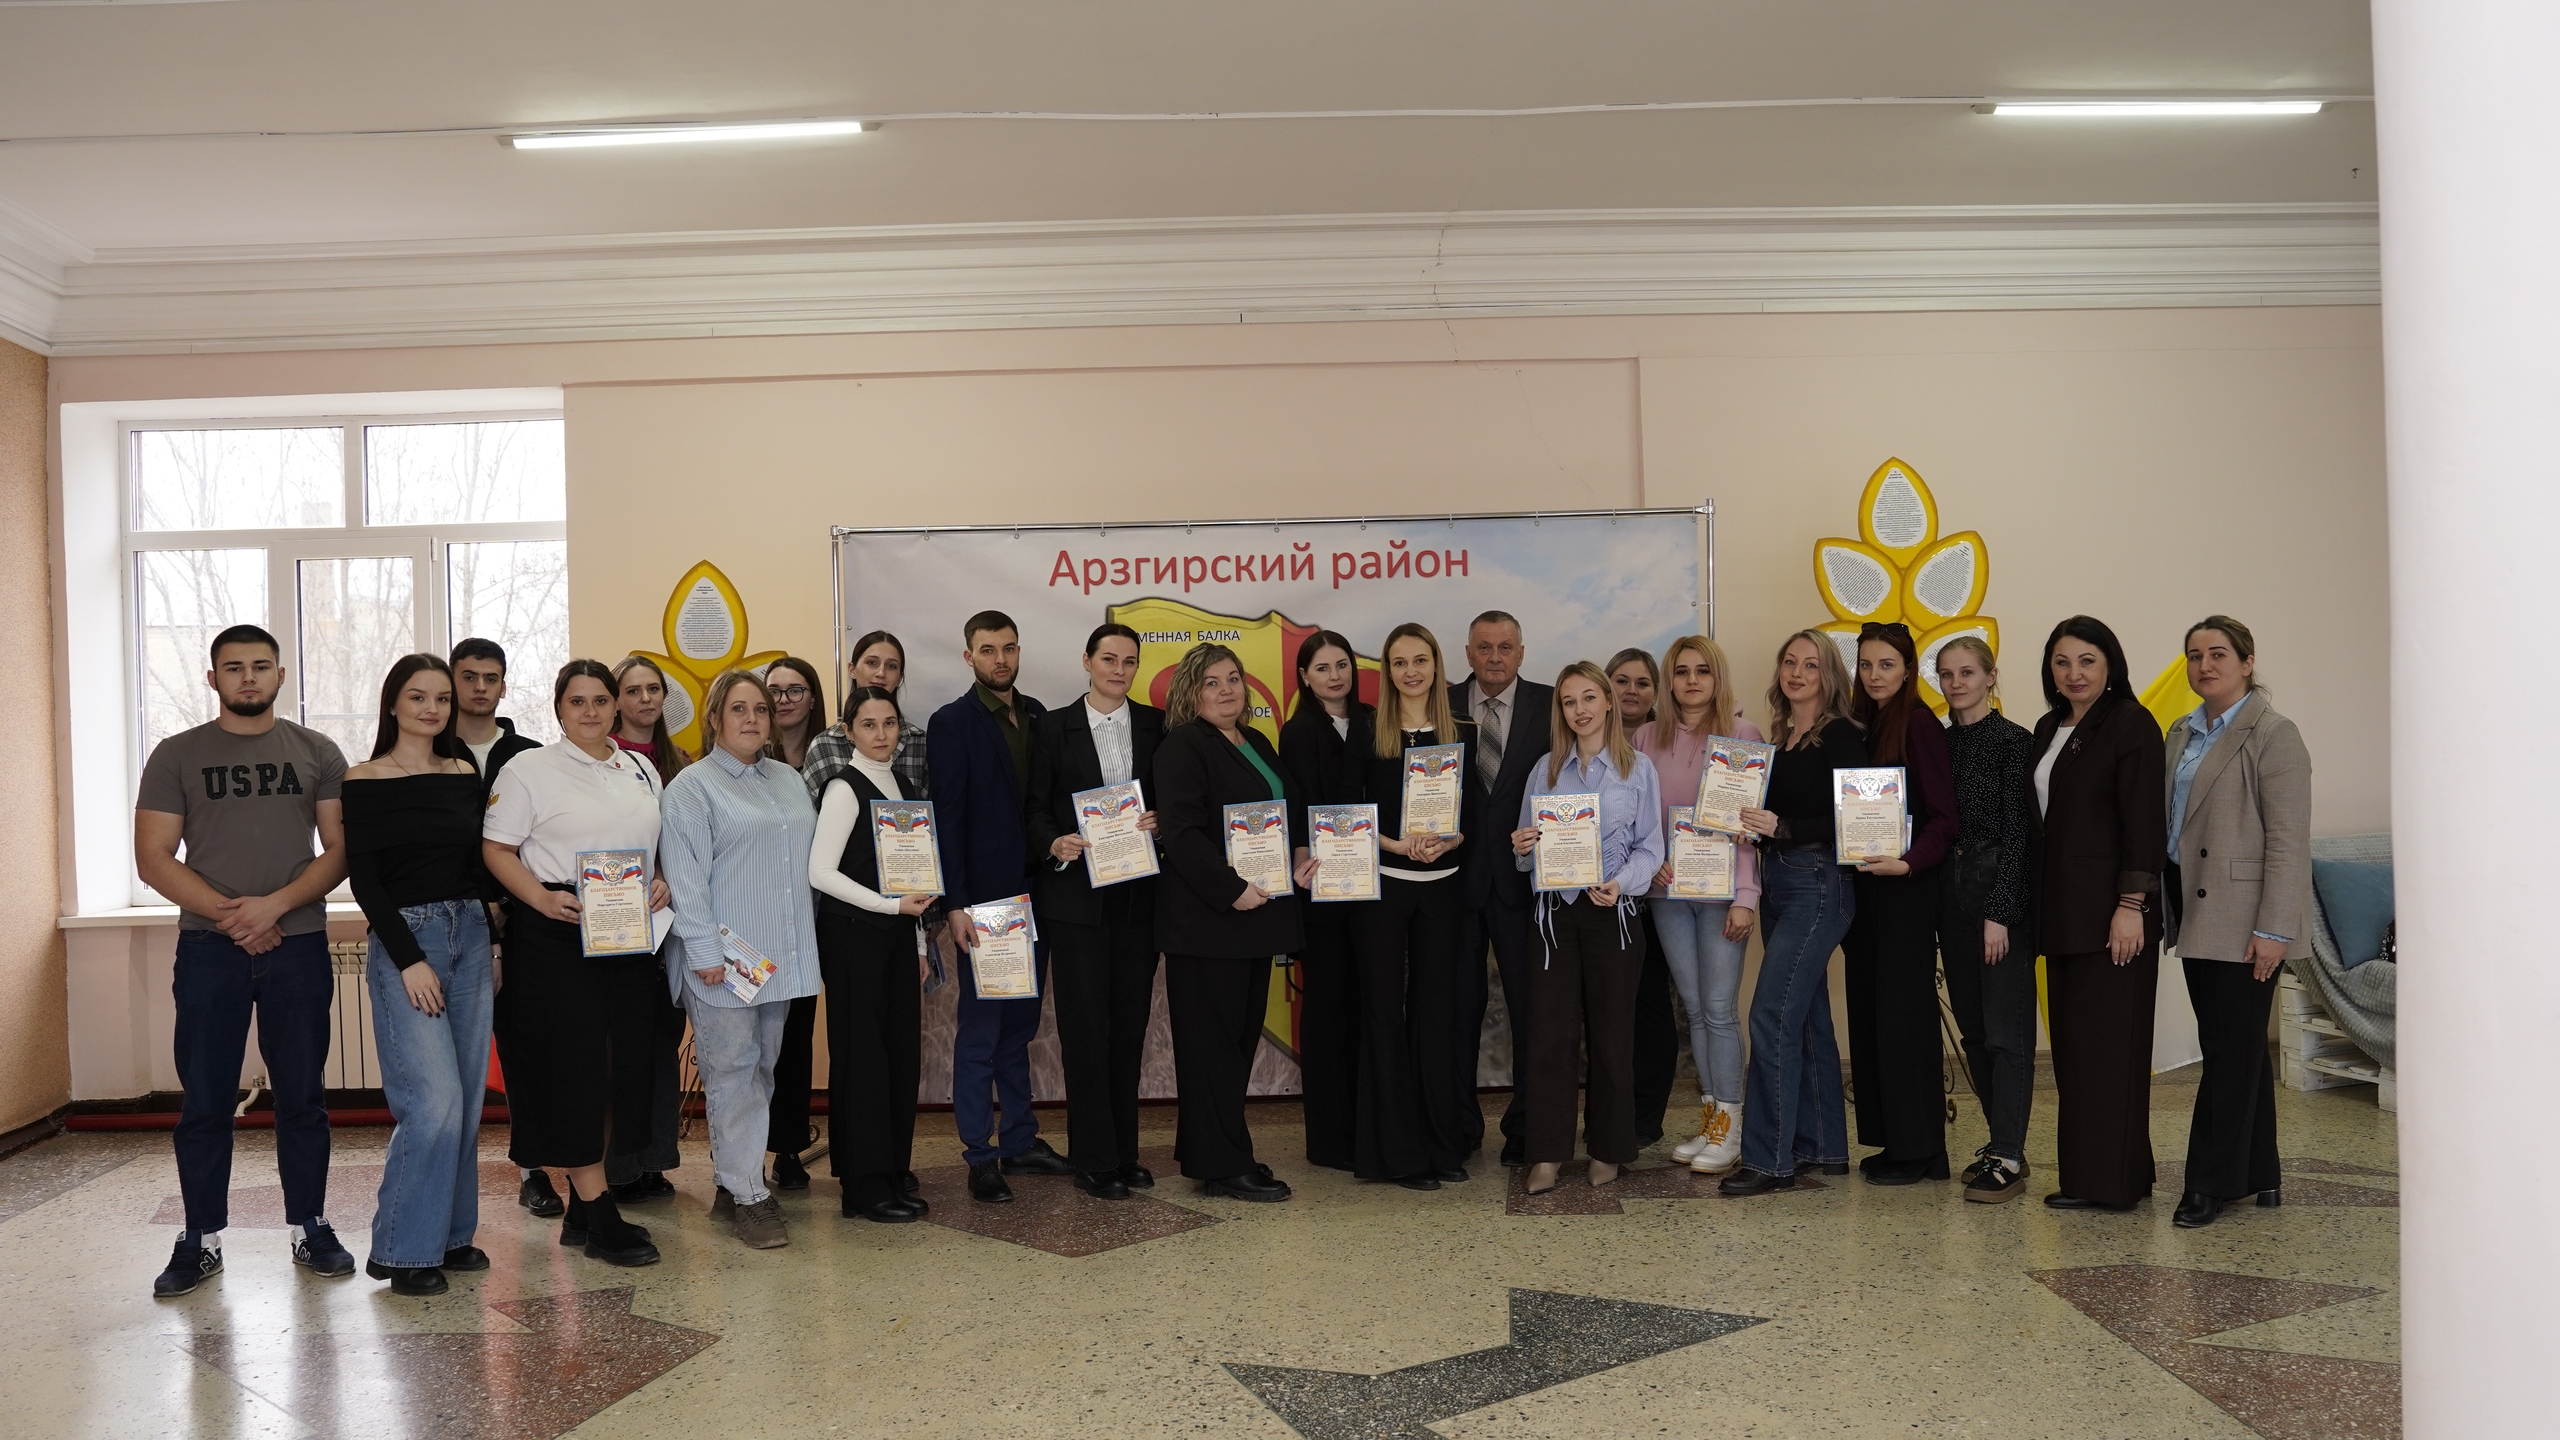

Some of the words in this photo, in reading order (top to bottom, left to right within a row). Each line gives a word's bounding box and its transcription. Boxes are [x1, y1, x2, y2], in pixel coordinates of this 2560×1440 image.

[1048, 541, 1315, 596] Арзгирский
[1331, 539, 1469, 589] район
[1137, 631, 1192, 643] МЕННАЯ
[1197, 630, 1240, 642] БАЛКА
[202, 762, 303, 800] USPA
